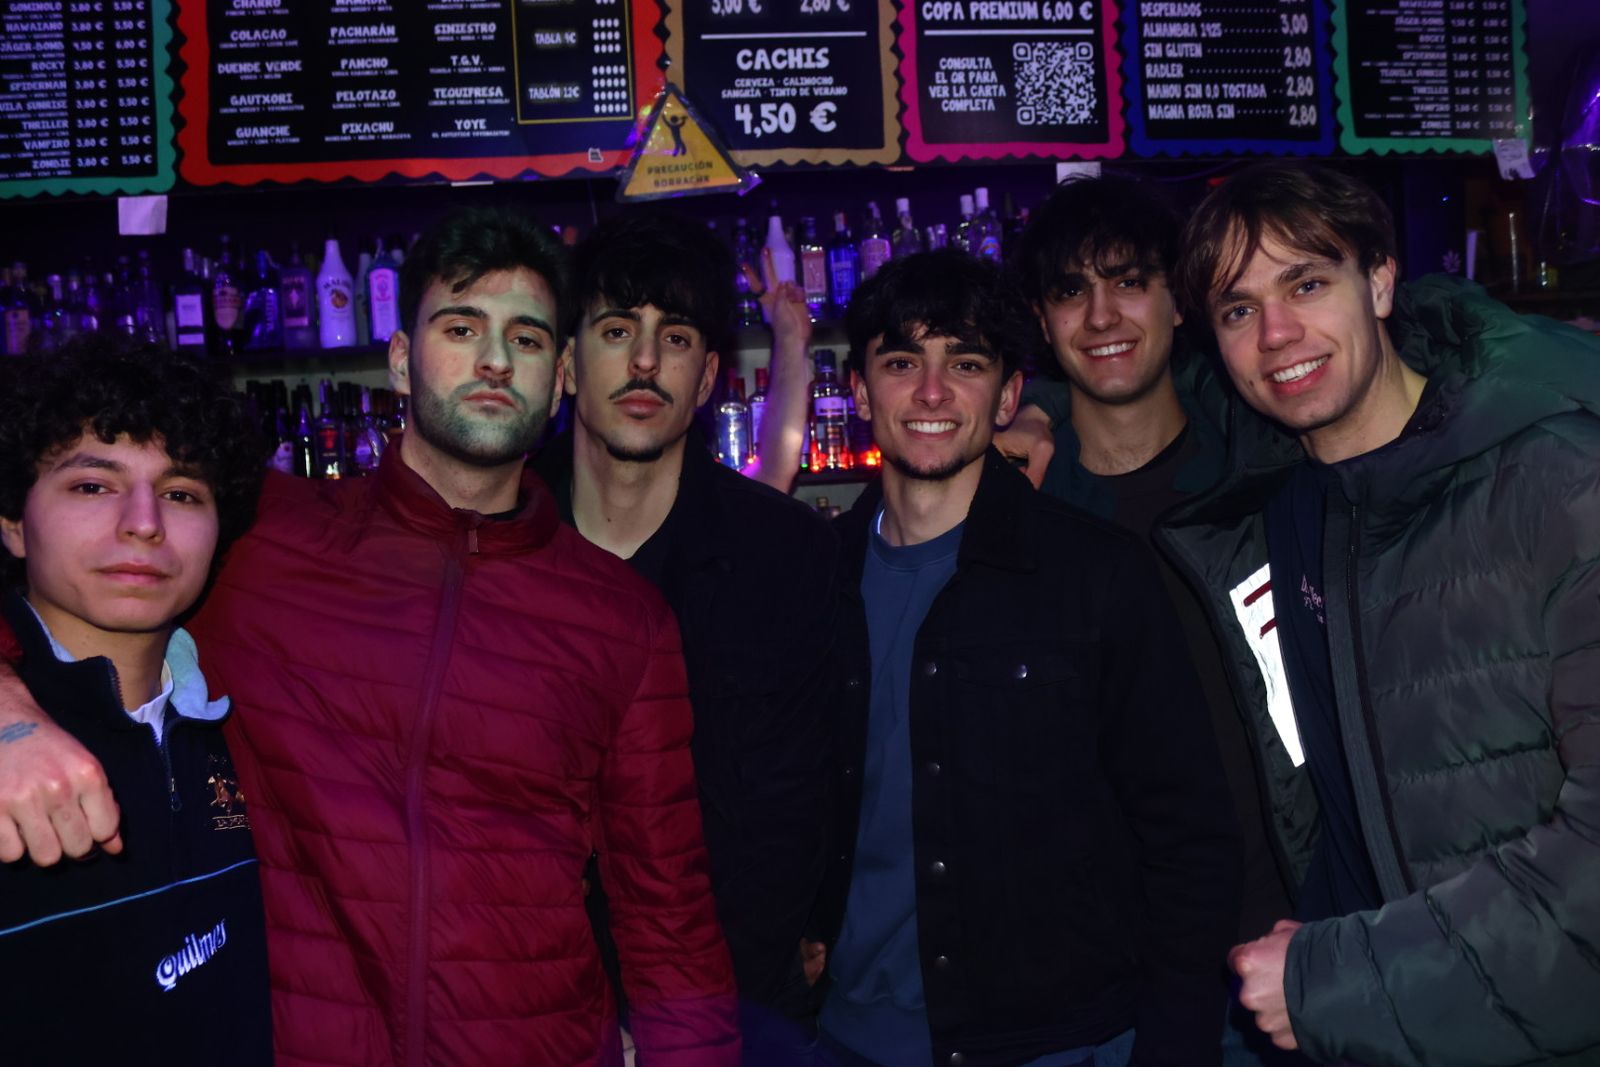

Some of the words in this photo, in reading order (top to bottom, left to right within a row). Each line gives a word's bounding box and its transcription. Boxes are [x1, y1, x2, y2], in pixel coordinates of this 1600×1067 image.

[233, 0, 281, 8] CHARRO
[748, 0, 762, 14] €
[1141, 2, 1201, 17] DESPERADOS
[922, 2, 965, 20] COPA
[970, 1, 1038, 20] PREMIUM
[1042, 1, 1073, 22] 6,00
[1079, 1, 1093, 20] €
[6, 22, 64, 32] HAWAIANO
[330, 22, 395, 38] PACHARÁN
[434, 22, 496, 34] SINIESTRO
[1143, 22, 1197, 37] ALHAMBRA
[1280, 13, 1308, 37] 3,00
[230, 29, 286, 41] COLACAO
[534, 32, 562, 44] TABLA
[1144, 42, 1162, 57] SIN
[1166, 42, 1202, 57] GLUTEN
[340, 57, 388, 70] PANCHO
[450, 54, 484, 66] T.G.V.
[736, 47, 829, 71] CACHIS
[939, 57, 992, 70] CONSULTA
[1283, 46, 1311, 69] 2,80
[217, 61, 261, 74] DUENDE
[265, 60, 302, 72] VERDE
[1145, 63, 1184, 78] RADLER
[734, 77, 775, 88] CERVEZA
[782, 76, 833, 87] CALIMOCHO
[935, 72, 947, 84] EL
[951, 72, 967, 84] QR
[968, 71, 998, 84] PARA
[433, 86, 503, 98] TEQUIFRESA
[528, 84, 560, 99] TABLÓN
[721, 87, 761, 99] SANGRÍA
[770, 86, 797, 98] TINTO
[799, 87, 811, 97] DE
[812, 86, 848, 97] VERANO
[928, 85, 949, 98] VER
[952, 85, 967, 98] LA
[970, 84, 1007, 98] CARTA
[1184, 83, 1202, 98] SIN
[1222, 83, 1267, 98] TOSTADA
[1286, 76, 1314, 98] 2,80
[230, 93, 292, 106] GAUTXORI
[335, 89, 396, 102] PELOTAZO
[941, 98, 995, 112] COMPLETA
[1148, 104, 1185, 120] MAGNA
[1216, 104, 1235, 119] SIN
[734, 102, 797, 138] 4,50
[809, 101, 838, 133] €
[1289, 105, 1317, 127] 2,80
[342, 121, 394, 134] PIKACHU
[454, 118, 487, 130] YOYE
[235, 125, 290, 138] GUANCHE
[24, 139, 70, 150] VAMPIRO
[647, 160, 713, 174] PRECAUCIÓN
[156, 917, 227, 993] Quilmes
